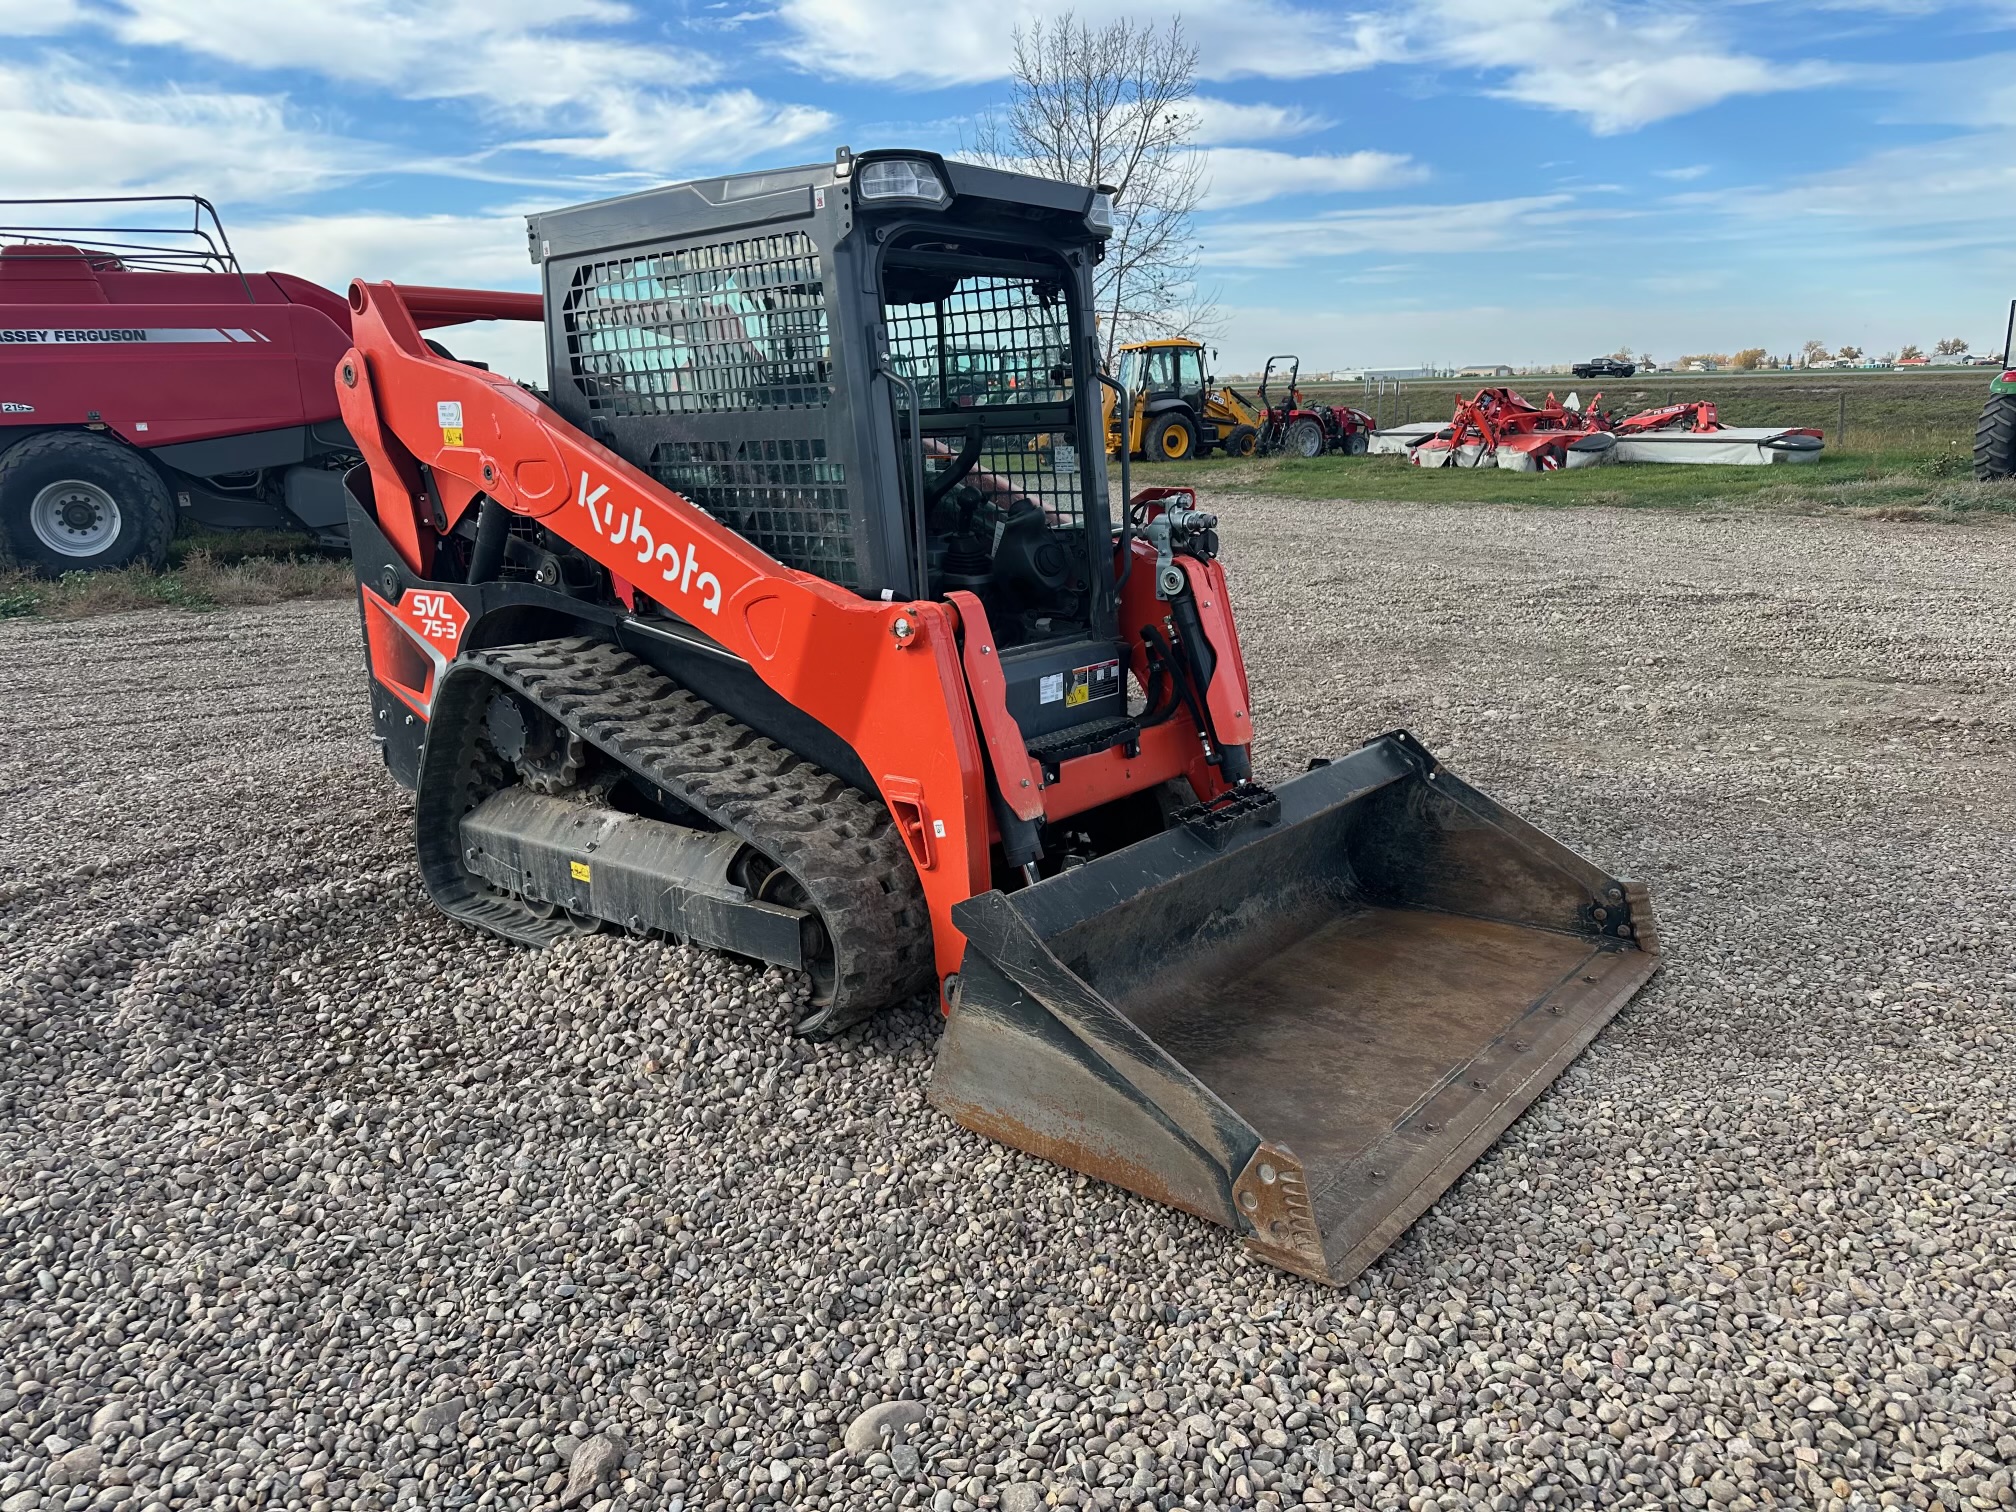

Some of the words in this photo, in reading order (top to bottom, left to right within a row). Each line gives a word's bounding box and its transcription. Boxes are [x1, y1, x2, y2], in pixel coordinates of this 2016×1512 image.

[54, 330, 147, 342] FERGUSON
[578, 471, 722, 616] Kubota
[412, 594, 453, 620] SVL
[422, 619, 457, 640] 75-3
